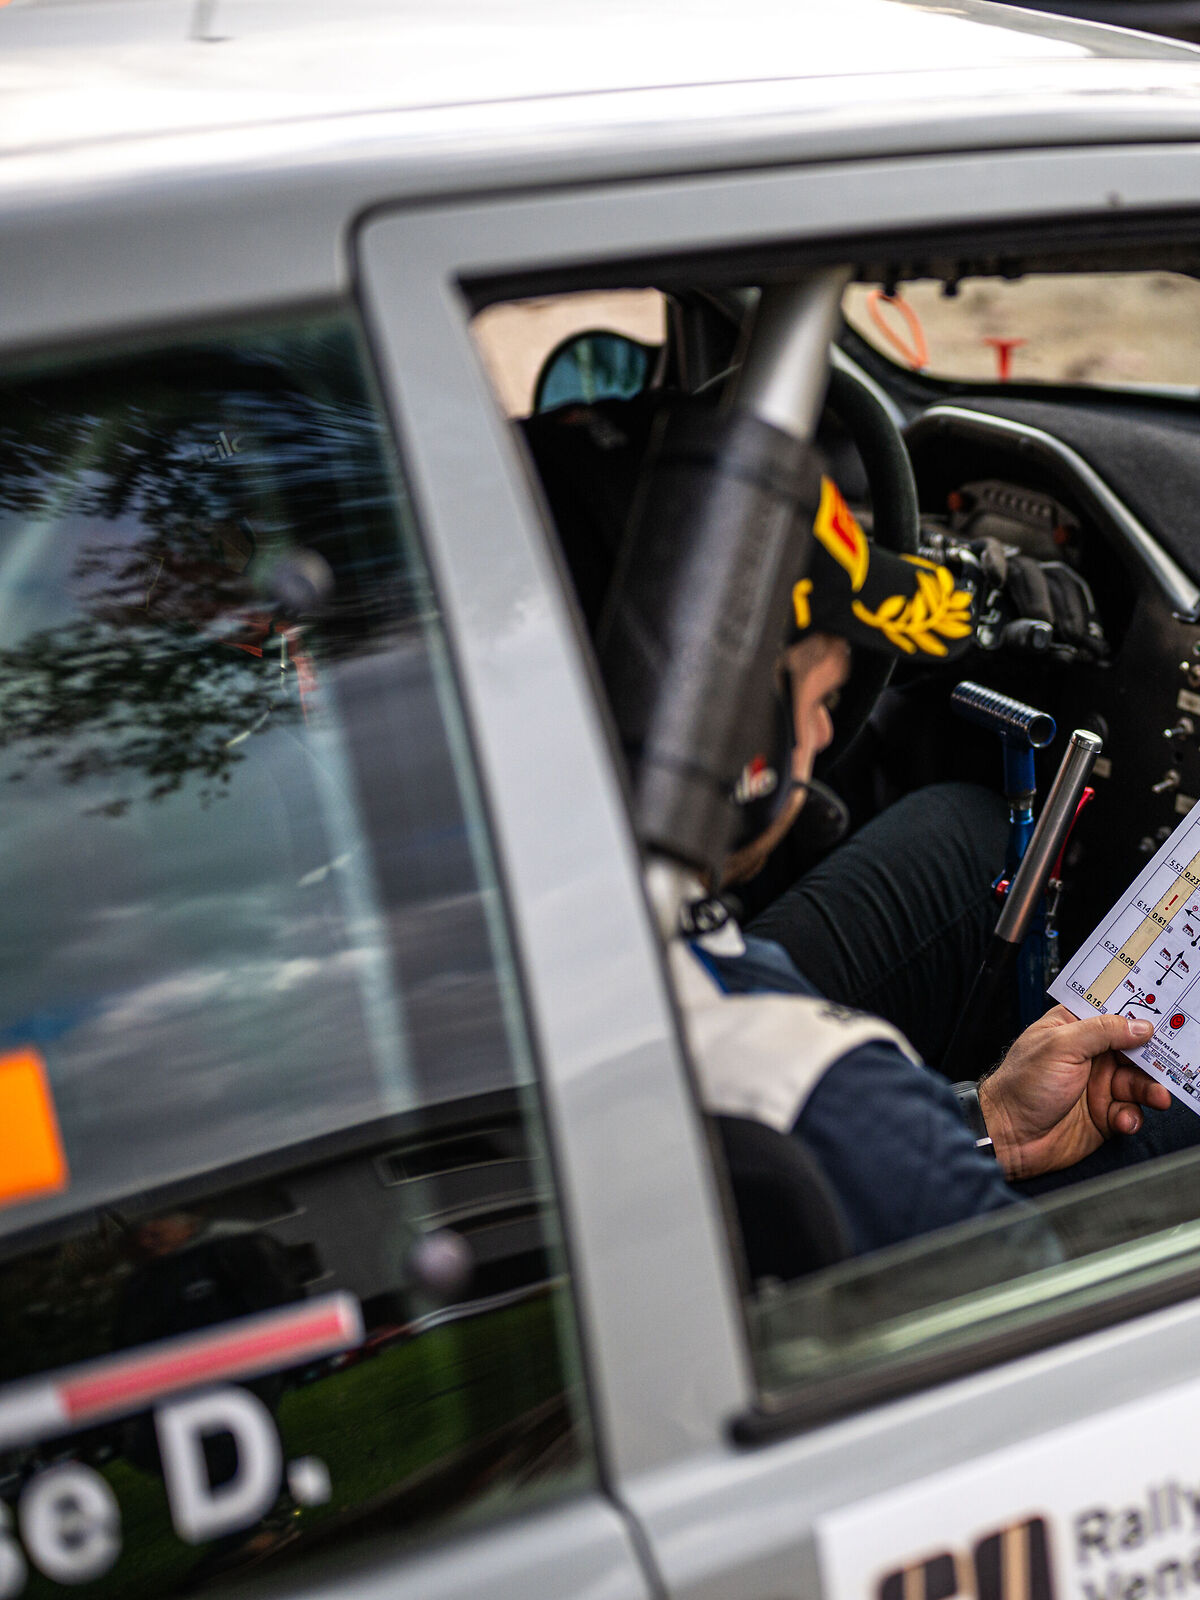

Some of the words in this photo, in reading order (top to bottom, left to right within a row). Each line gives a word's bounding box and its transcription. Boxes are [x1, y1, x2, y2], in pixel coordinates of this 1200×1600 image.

[1169, 859, 1185, 873] 5.53
[1184, 872, 1200, 886] 0.23
[1136, 900, 1152, 914] 6.14
[1151, 913, 1167, 926] 0.61
[1104, 940, 1119, 954] 6.23
[1118, 953, 1136, 967] 0.09
[1070, 981, 1087, 995] 6.38
[1085, 994, 1102, 1008] 0.15
[1152, 1035, 1165, 1045] Service
[1163, 1042, 1171, 1050] Park
[1171, 1050, 1181, 1059] entry
[152, 1382, 333, 1547] D.
